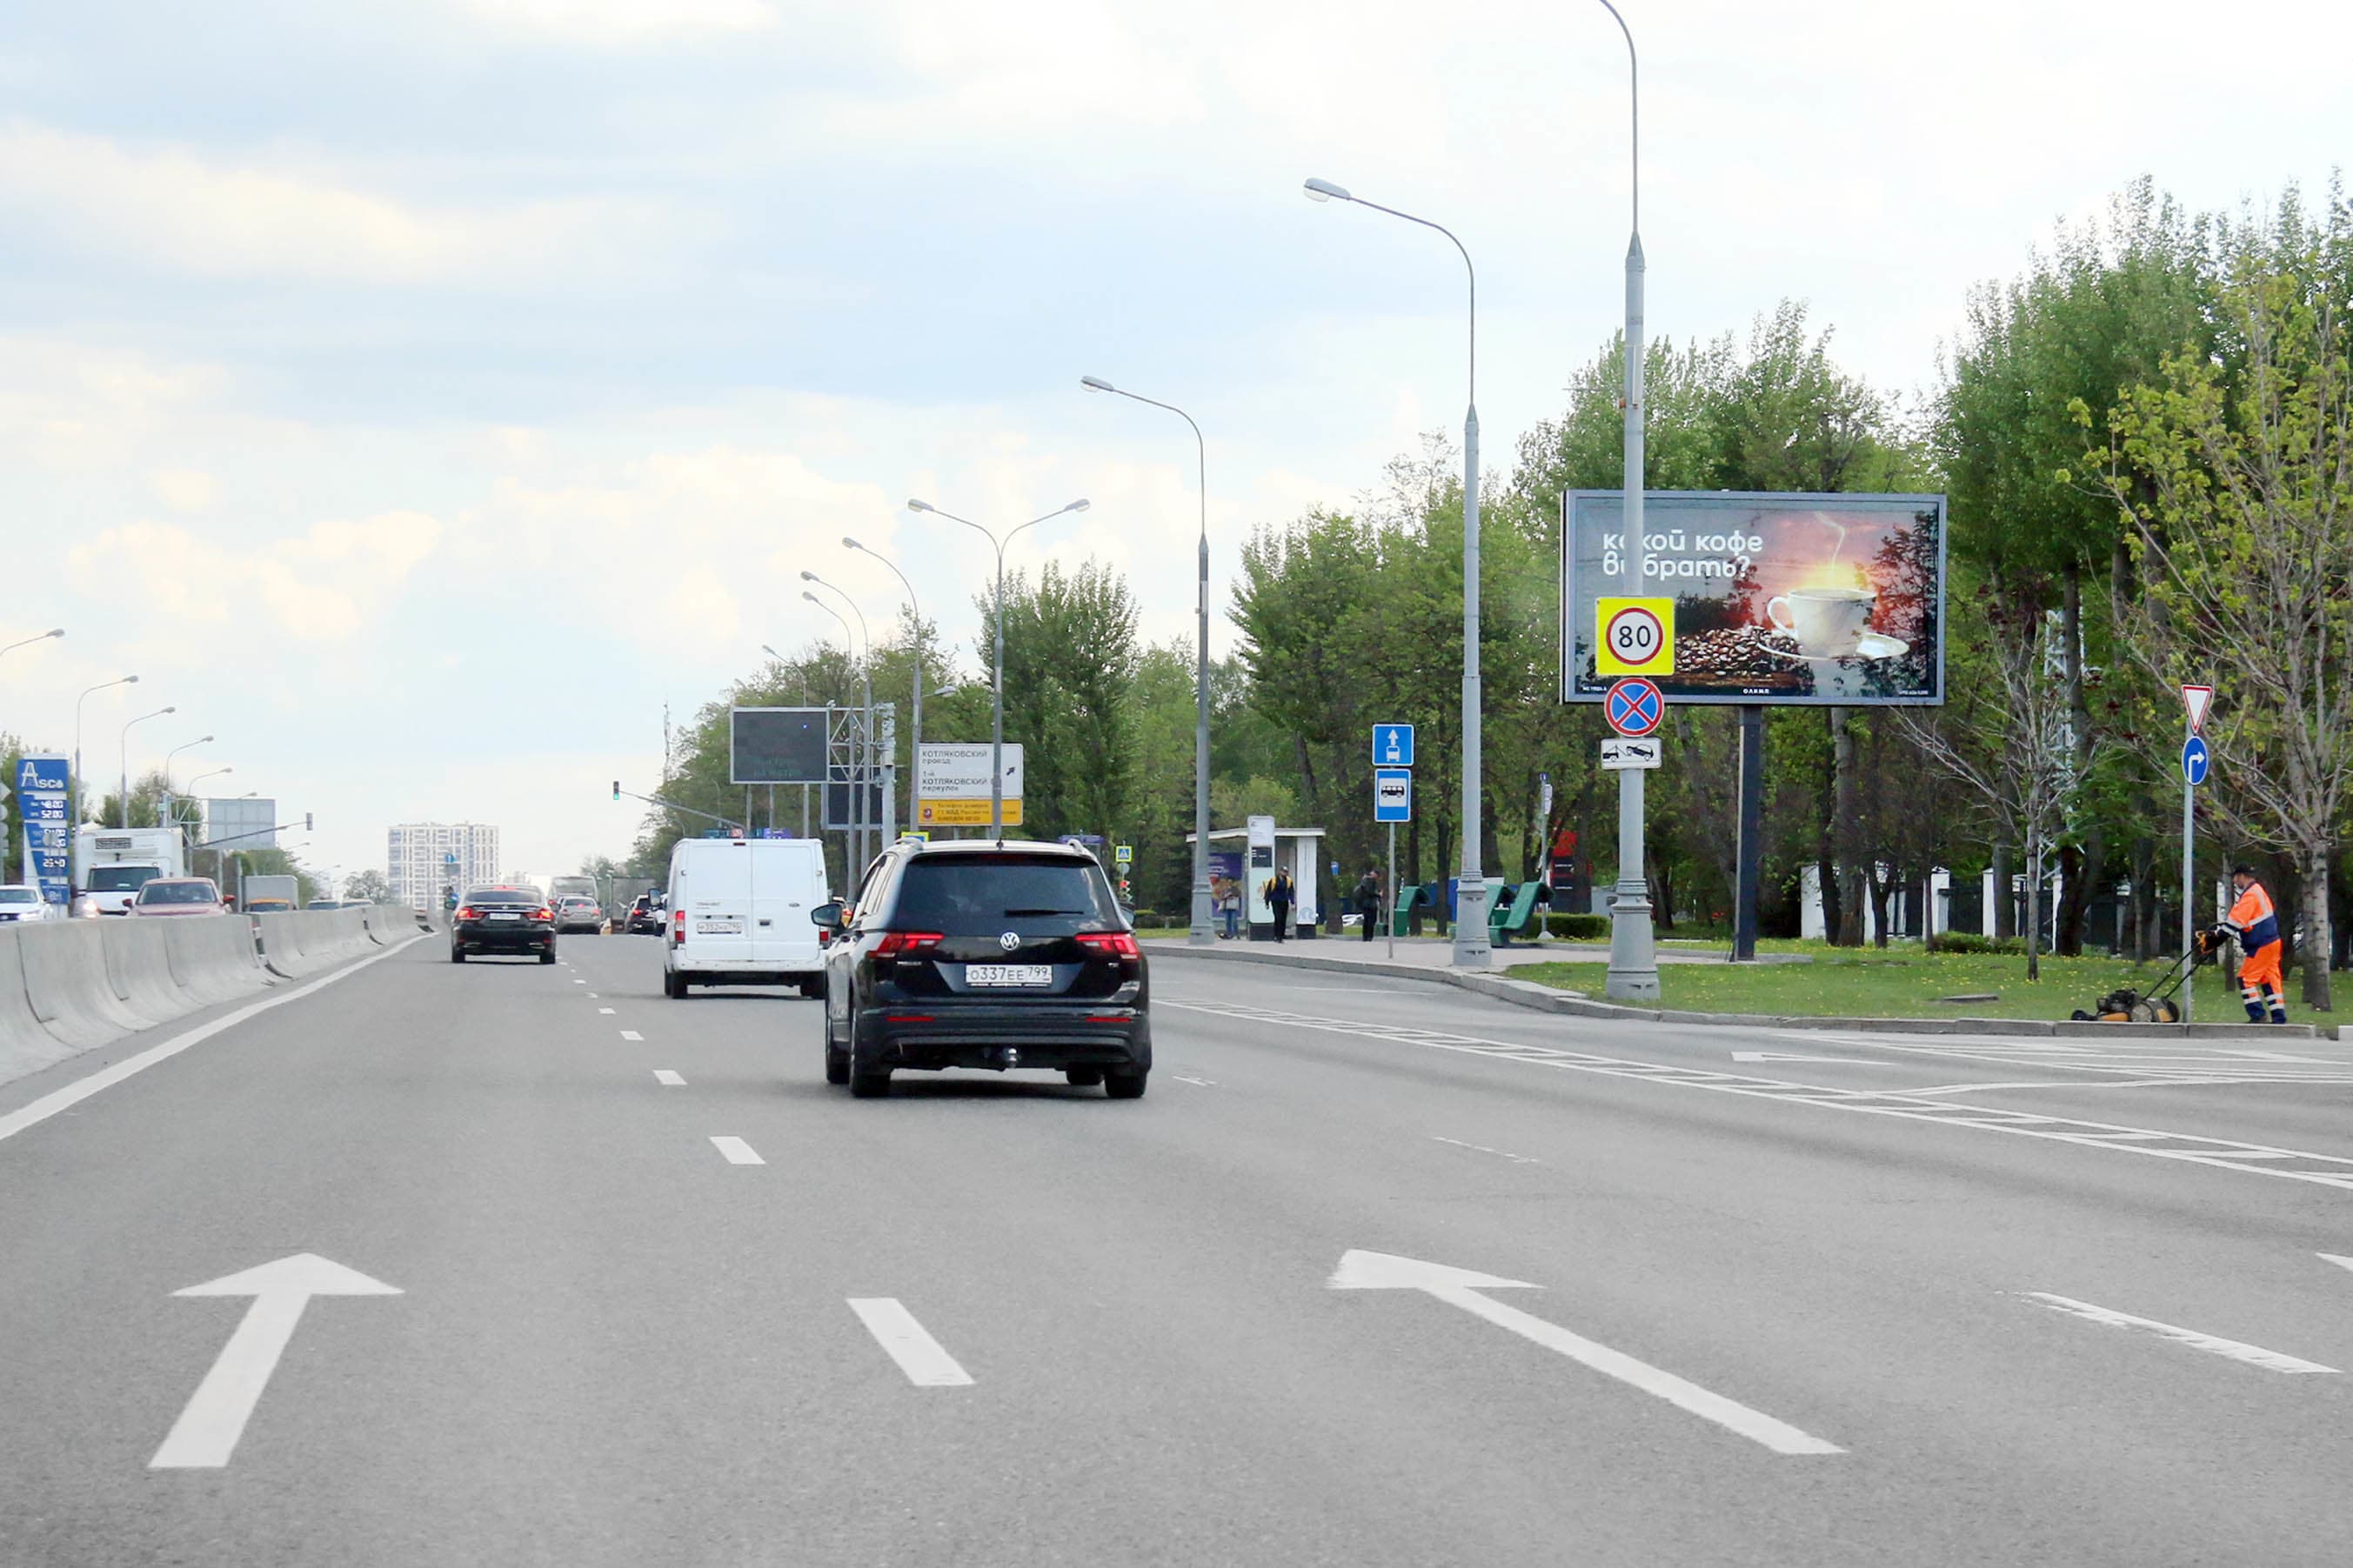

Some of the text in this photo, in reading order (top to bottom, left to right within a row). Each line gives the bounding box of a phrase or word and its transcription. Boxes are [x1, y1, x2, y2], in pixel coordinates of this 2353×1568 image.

[1696, 530, 1763, 557] кофе
[1603, 550, 1751, 581] вбрать?
[1619, 625, 1650, 648] 80
